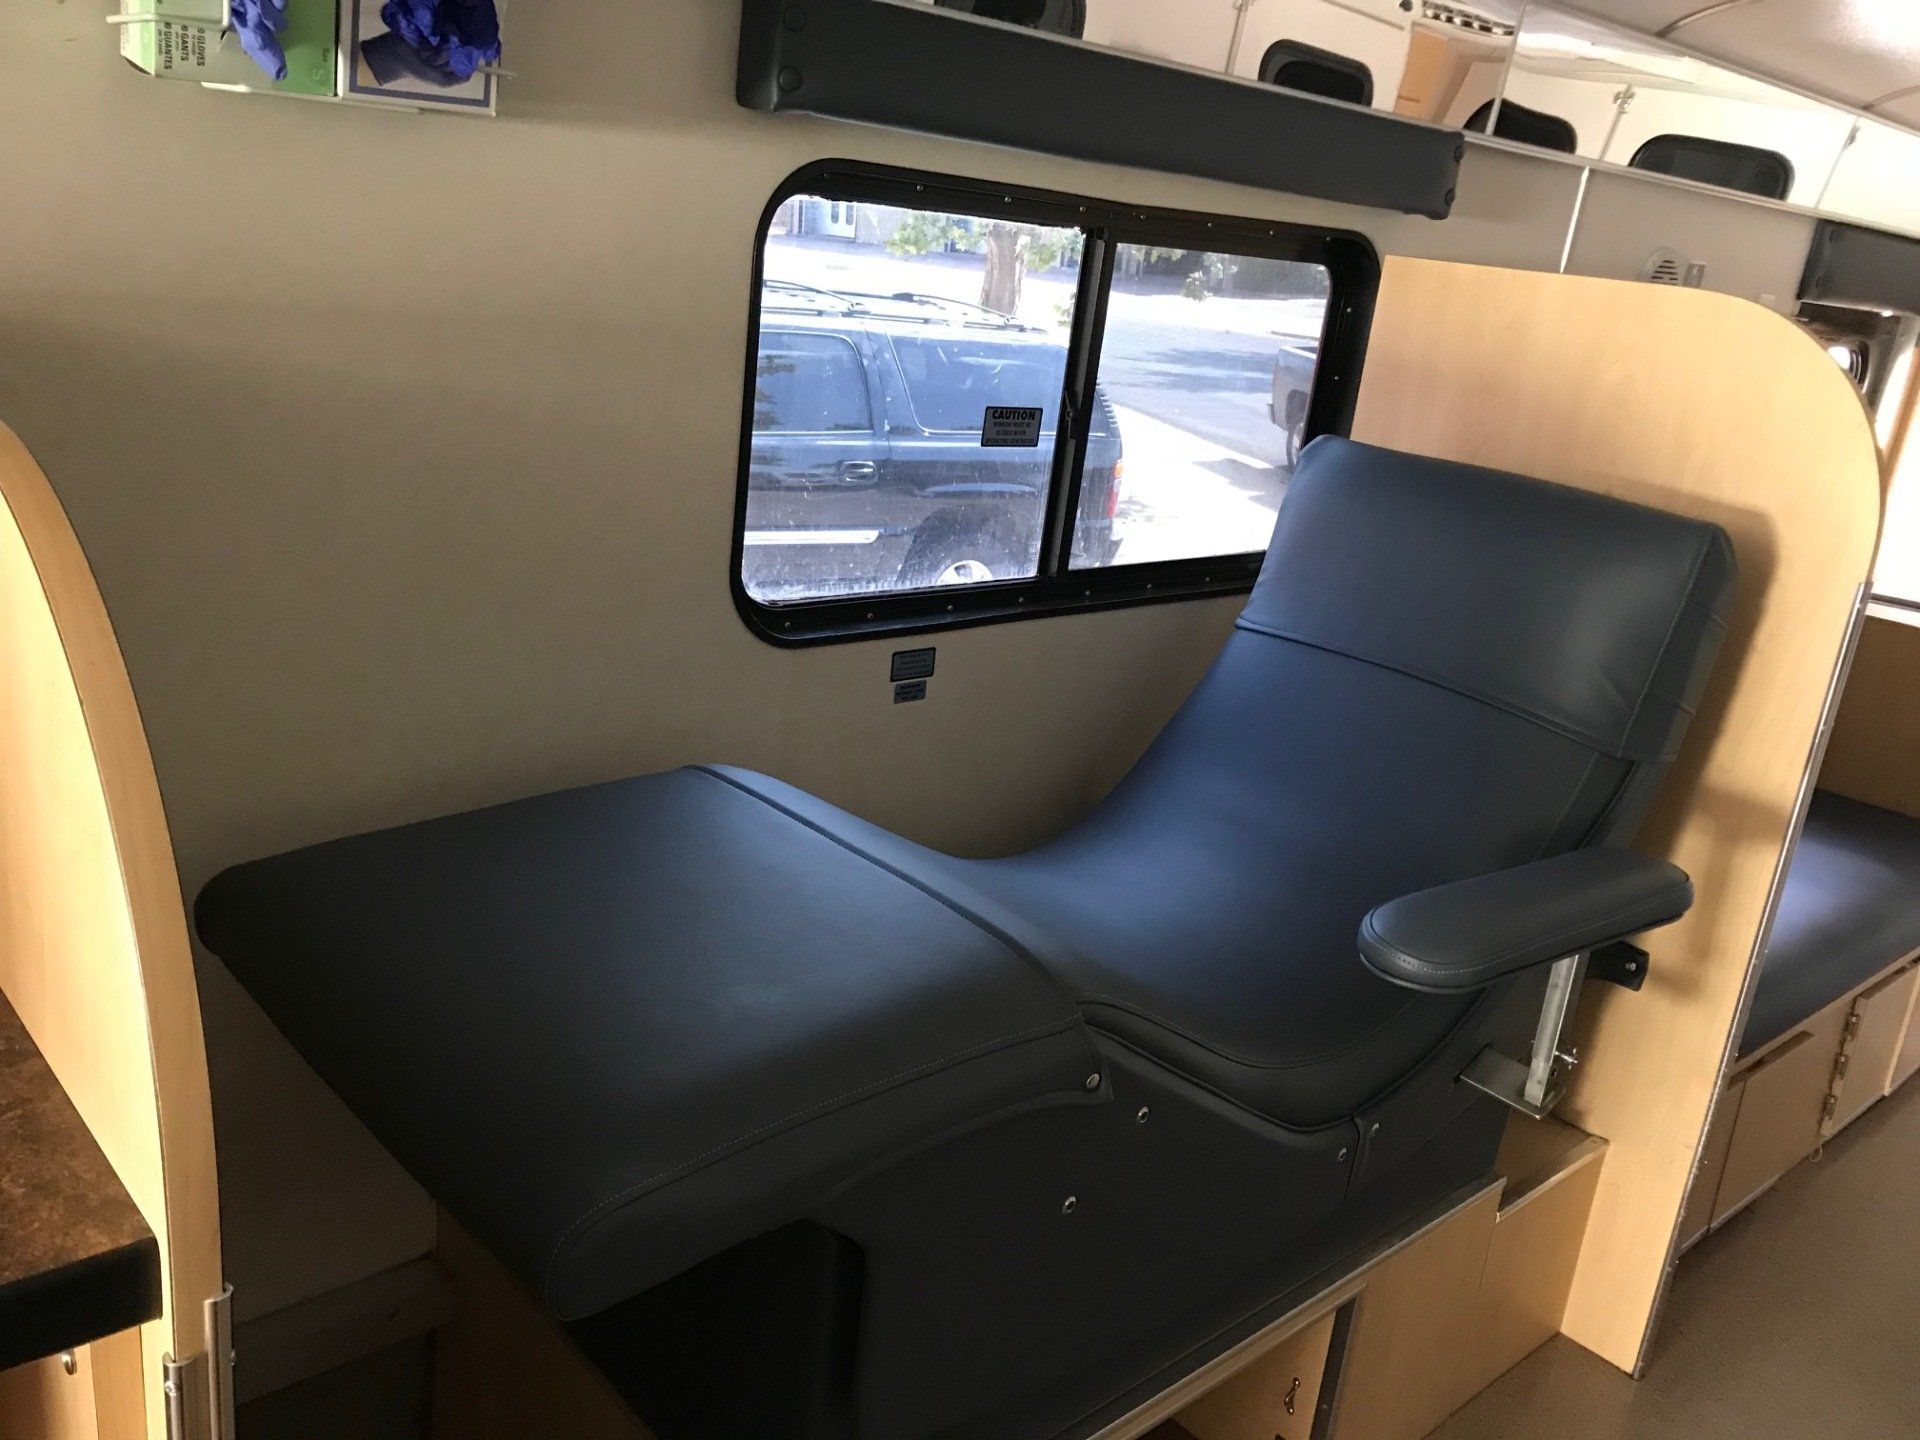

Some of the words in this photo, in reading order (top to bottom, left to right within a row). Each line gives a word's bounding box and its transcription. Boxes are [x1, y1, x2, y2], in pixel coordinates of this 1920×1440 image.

[164, 30, 172, 70] GUANTES
[181, 33, 190, 62] GANTS
[196, 35, 206, 67] GLOVES
[992, 409, 1036, 421] CAUTION
